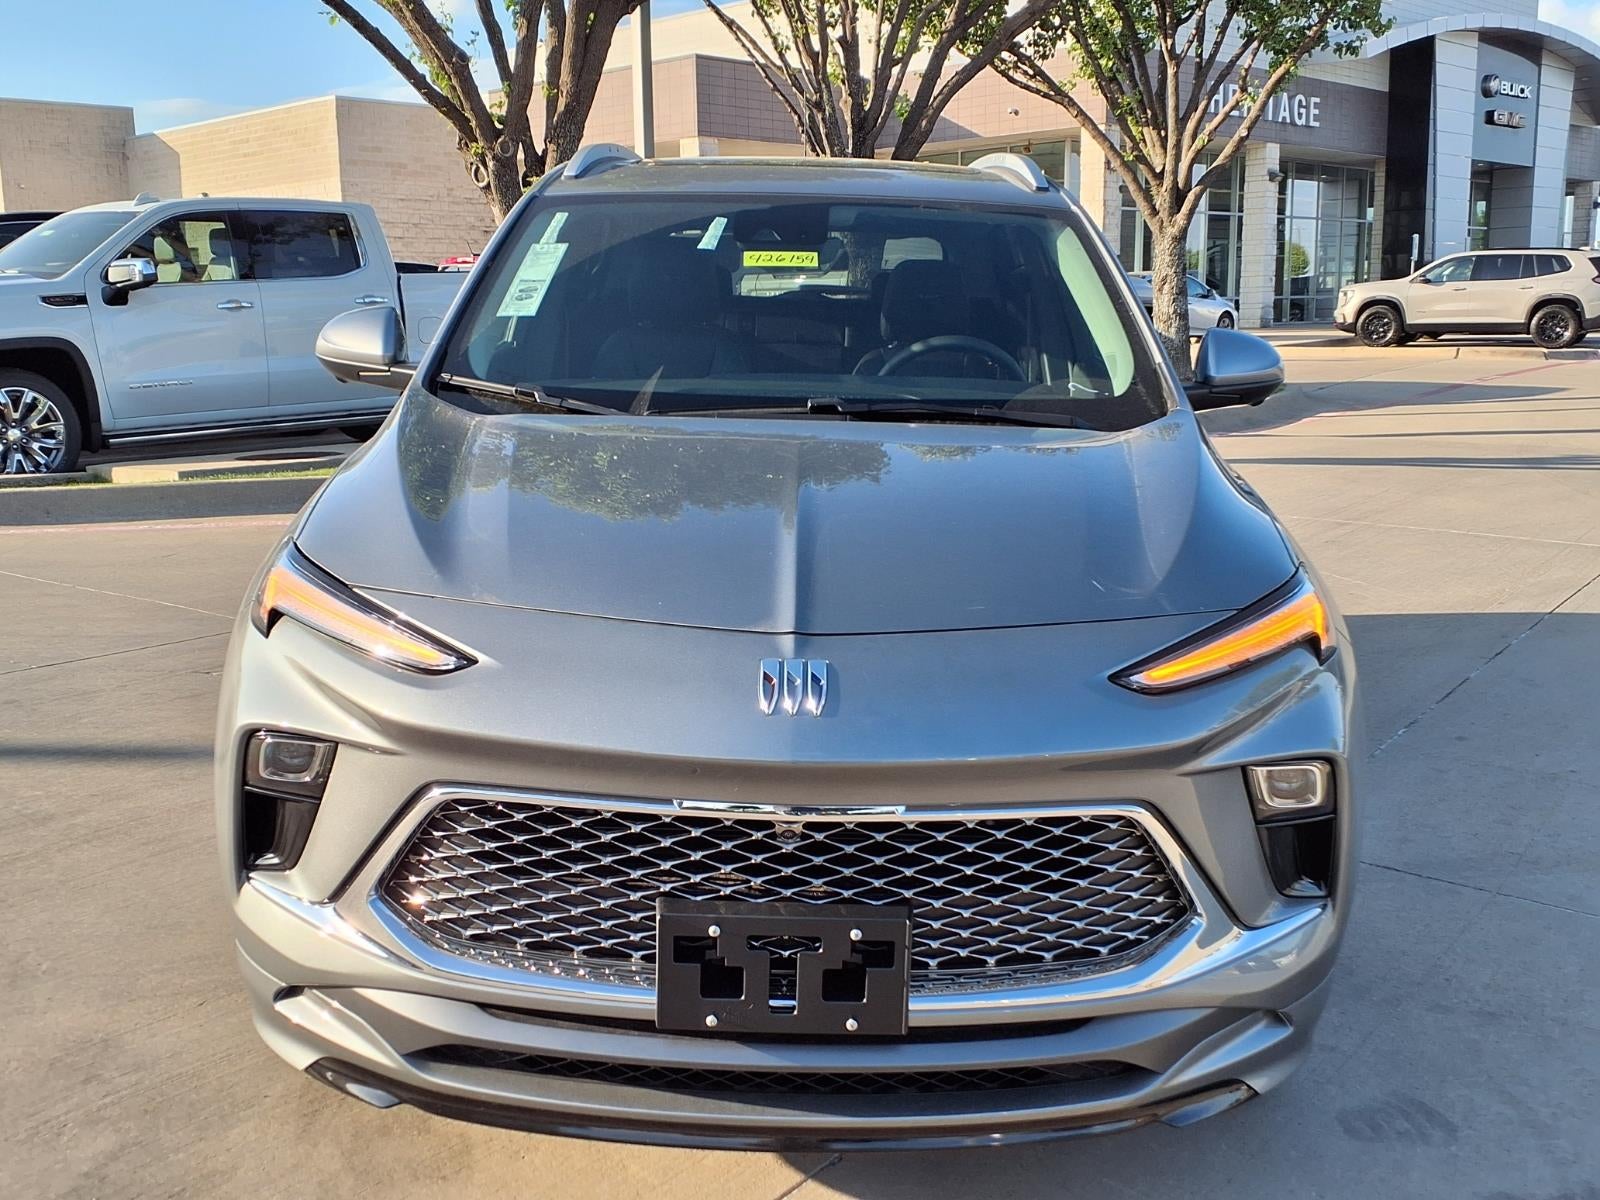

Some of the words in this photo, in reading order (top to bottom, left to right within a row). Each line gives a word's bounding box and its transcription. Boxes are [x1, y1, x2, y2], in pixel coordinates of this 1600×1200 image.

[1500, 81, 1532, 98] BUICK
[1209, 82, 1321, 128] HETAGE
[1494, 110, 1528, 127] GMC
